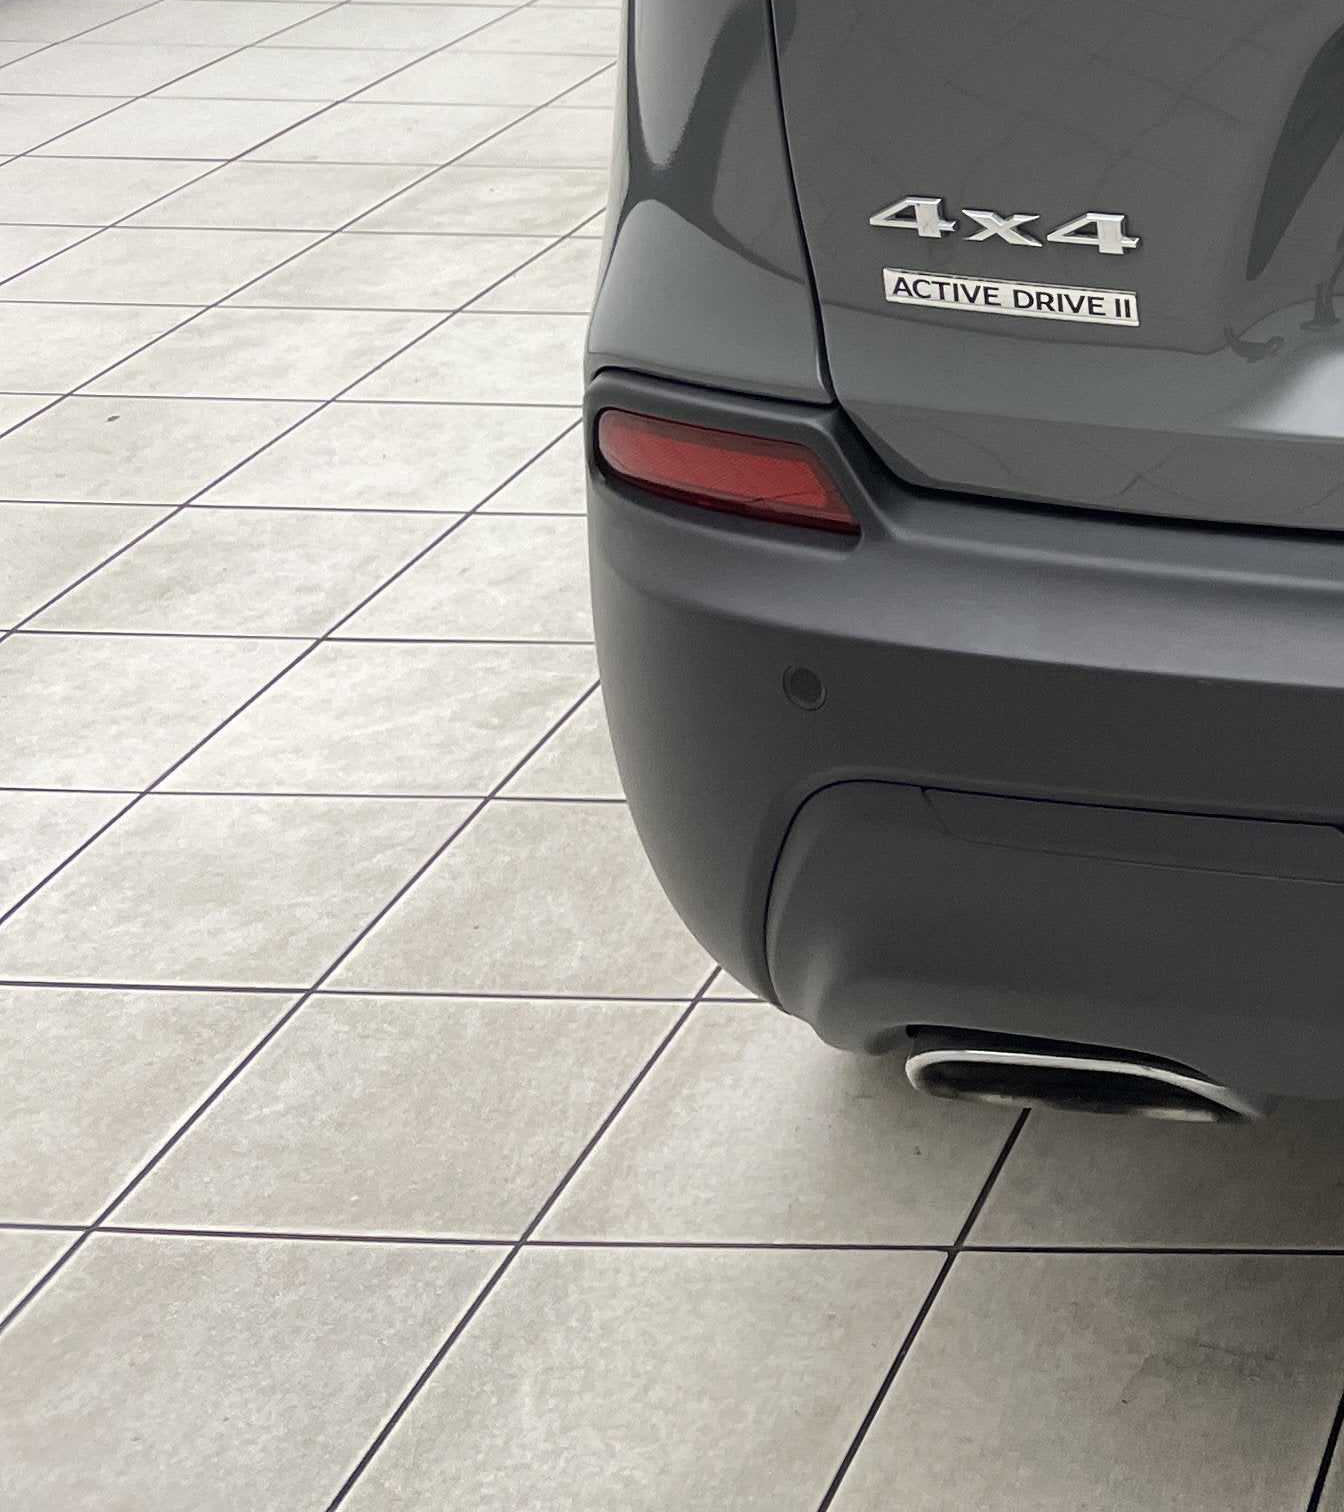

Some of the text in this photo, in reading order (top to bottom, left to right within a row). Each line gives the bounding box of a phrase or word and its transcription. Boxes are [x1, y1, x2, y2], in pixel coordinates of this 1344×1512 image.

[892, 276, 1131, 319] ACTIVE DRIVE II
